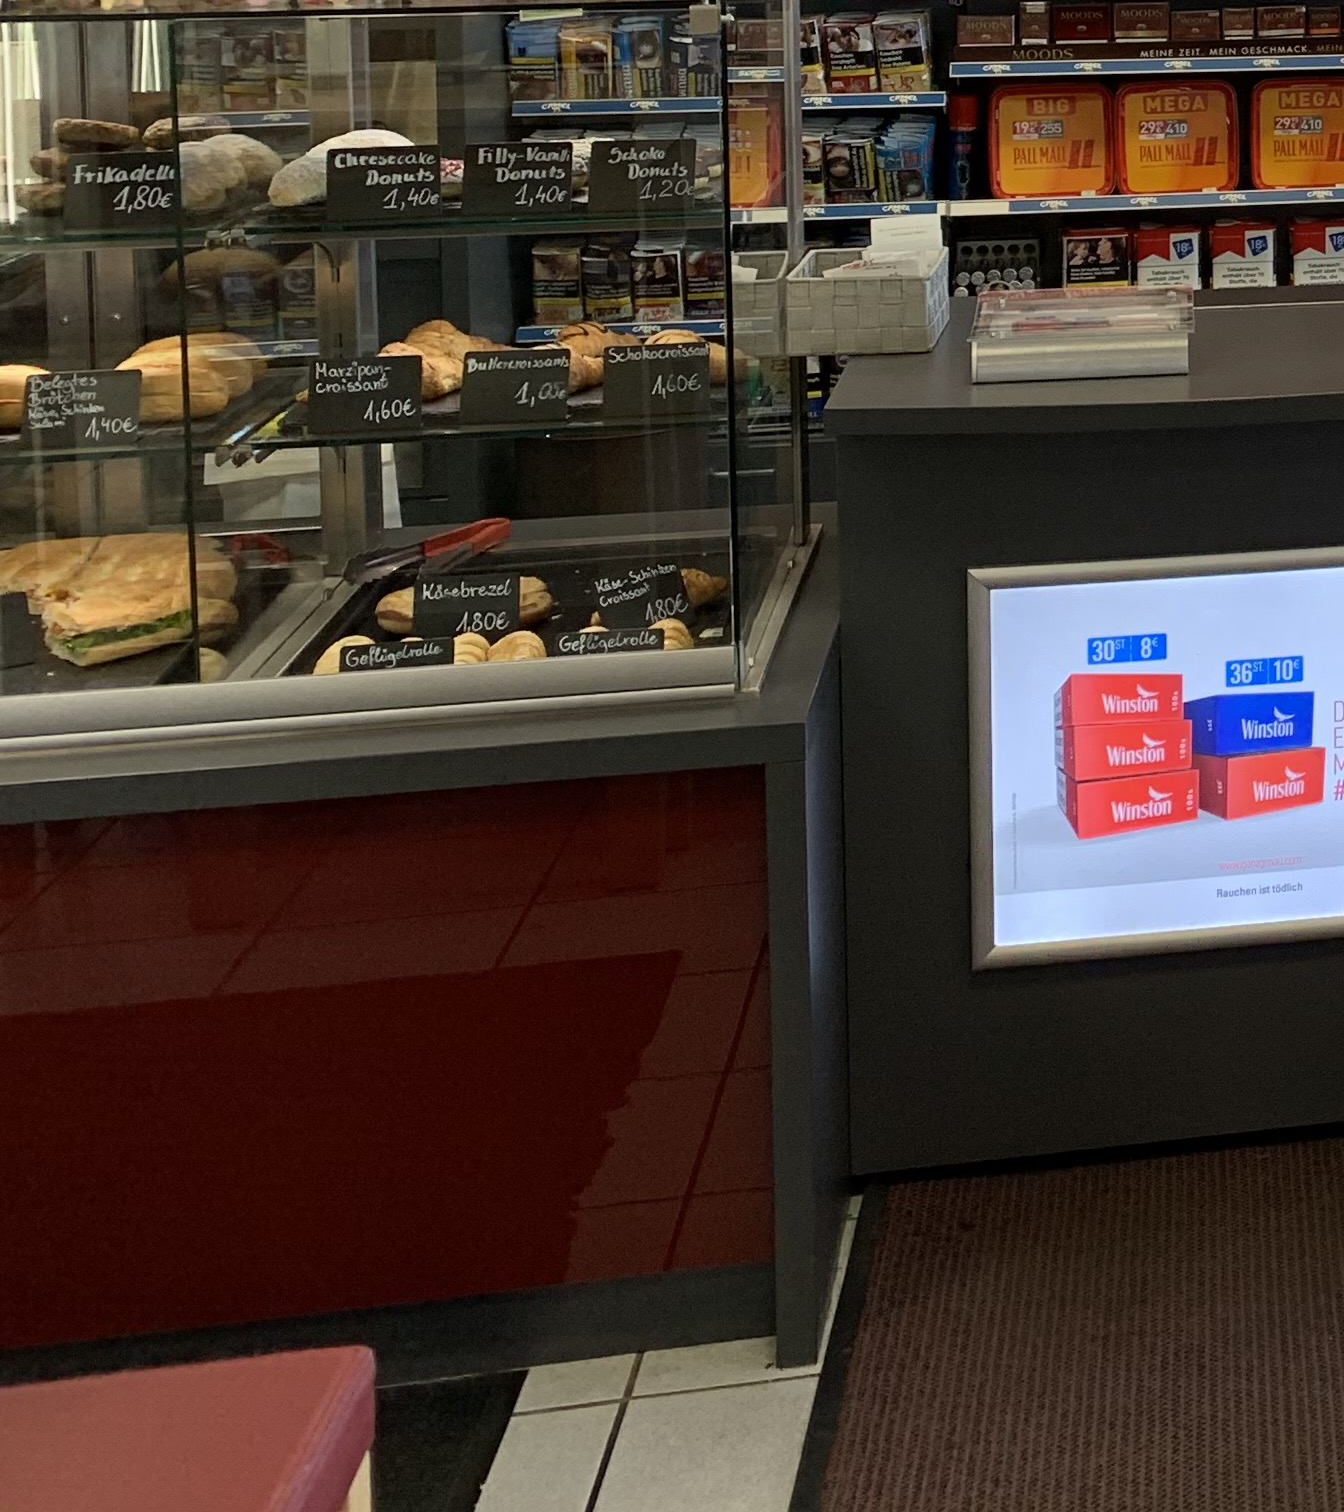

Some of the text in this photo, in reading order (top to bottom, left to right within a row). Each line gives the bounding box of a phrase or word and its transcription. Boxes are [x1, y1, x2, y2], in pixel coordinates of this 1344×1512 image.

[1140, 48, 1170, 57] MEINE
[1209, 47, 1238, 56] MEIN
[1030, 98, 1071, 115] BIG
[1144, 95, 1206, 113] MEGA
[1013, 146, 1067, 165] PALL MALL
[366, 168, 434, 186] Donuts
[113, 185, 173, 213] 1,80€
[383, 188, 439, 211] 1,40€
[315, 361, 391, 380] Marzipan-
[315, 373, 388, 394] croissant
[363, 400, 416, 421] 1,60€
[85, 417, 137, 441] 1,40€
[422, 578, 511, 599] Käsebrezel
[455, 611, 510, 632] 1,80€
[345, 642, 443, 668] Geflügelrolle
[1102, 693, 1159, 714] Winston
[1111, 798, 1172, 822] Winston
[1216, 881, 1303, 898] Rauchen ist tödlich
